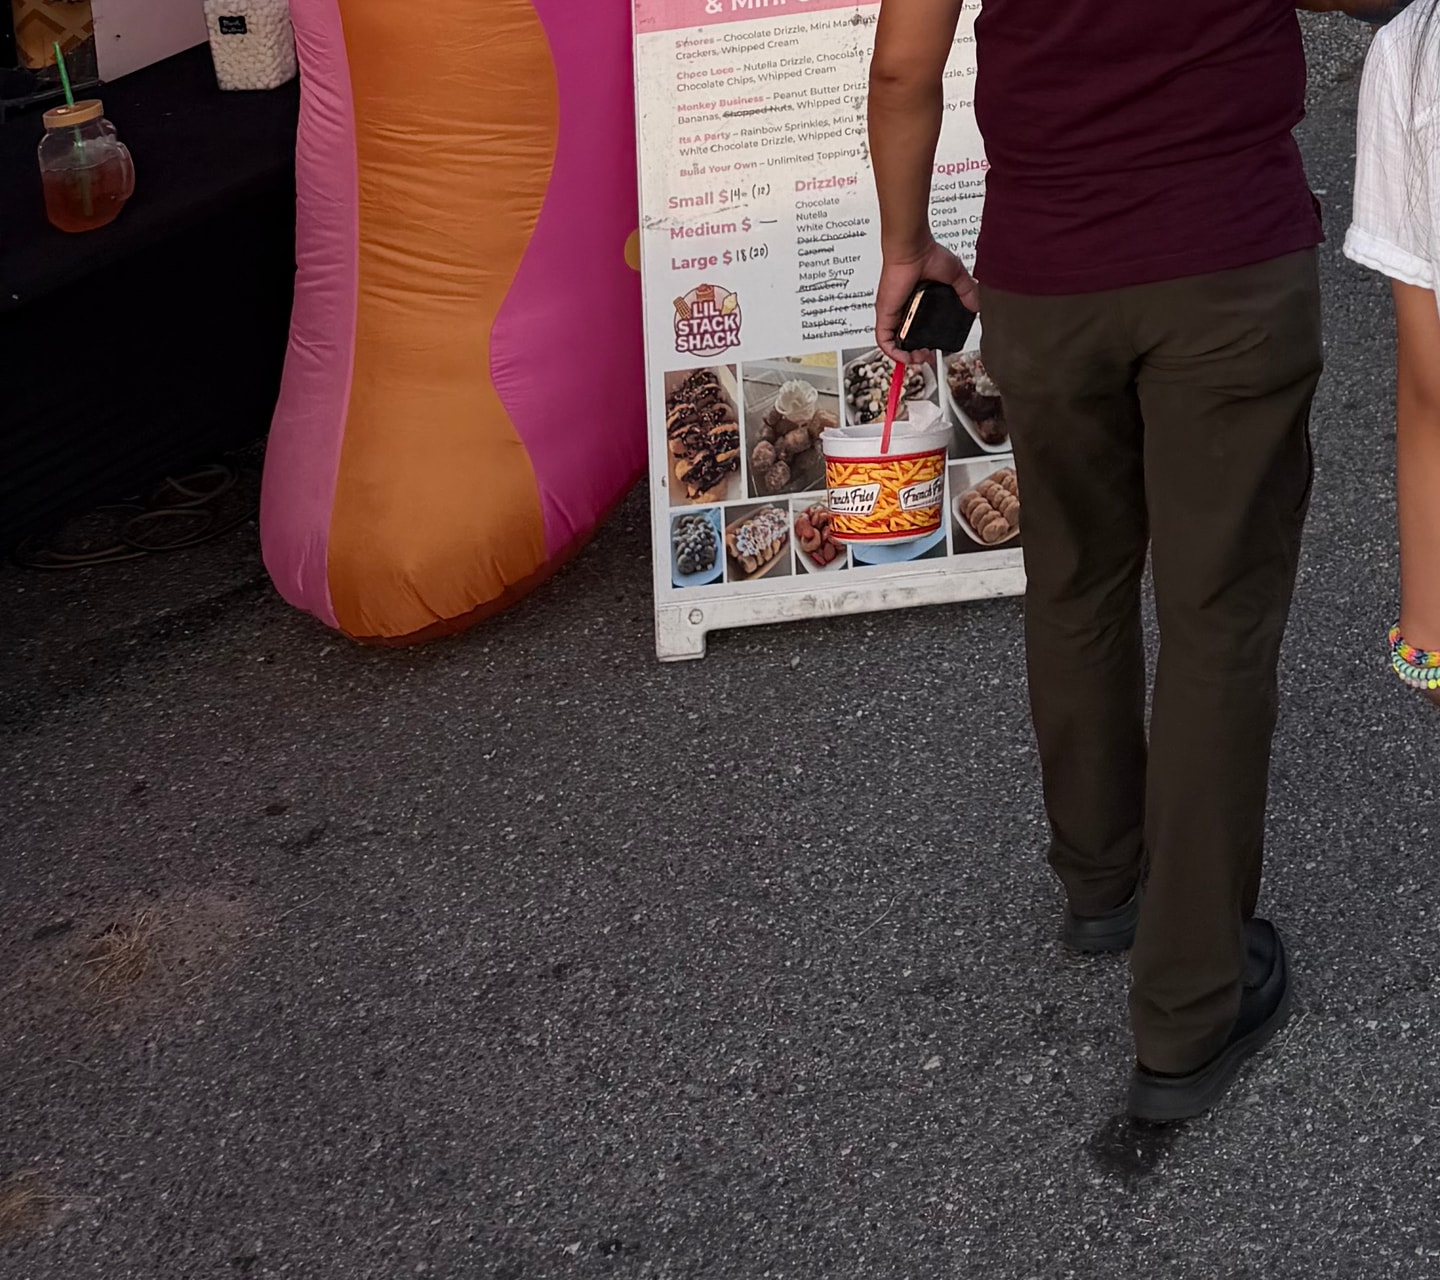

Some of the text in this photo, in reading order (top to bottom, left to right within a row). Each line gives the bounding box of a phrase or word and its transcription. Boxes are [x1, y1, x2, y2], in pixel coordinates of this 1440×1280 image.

[724, 29, 772, 43] Chocolate
[774, 23, 808, 37] Drizzle,
[810, 19, 831, 31] Mini
[676, 37, 799, 61] Crackers, Whipped Cream
[677, 68, 708, 81] Choco
[744, 57, 778, 72] Nutella
[780, 54, 814, 68] Drizzle,
[816, 47, 864, 63] Chocolate
[677, 64, 837, 92] Chocolate Chips, Whipped Cream
[677, 82, 867, 114] Monkey Business Peanut Butter Drizz
[678, 114, 720, 125] Bananas,
[797, 97, 841, 111] Whipped
[843, 95, 866, 104] Crea
[704, 131, 731, 144] Party
[740, 124, 783, 138] Rainbow
[784, 118, 831, 132] Sprinkles,
[833, 114, 854, 126] Mini
[679, 126, 866, 157] White Chocolate Drizzle, Whipped Crea
[708, 164, 731, 175] Your
[734, 160, 758, 171] Own
[767, 154, 814, 167] Unlimited
[934, 158, 989, 175] opping
[669, 191, 714, 209] Small
[795, 197, 840, 209] Chocolate
[796, 211, 828, 221] Nutella
[931, 207, 957, 216] Oreos
[670, 221, 737, 239] Medium
[797, 217, 870, 233] White Chocolate
[931, 216, 967, 228] Graham
[671, 253, 718, 271] Large
[799, 255, 861, 269] Peanut Butter
[799, 267, 855, 281] Maple Syrup
[692, 301, 720, 318] LIL
[678, 315, 737, 335] STACK
[677, 330, 739, 351] SHACK
